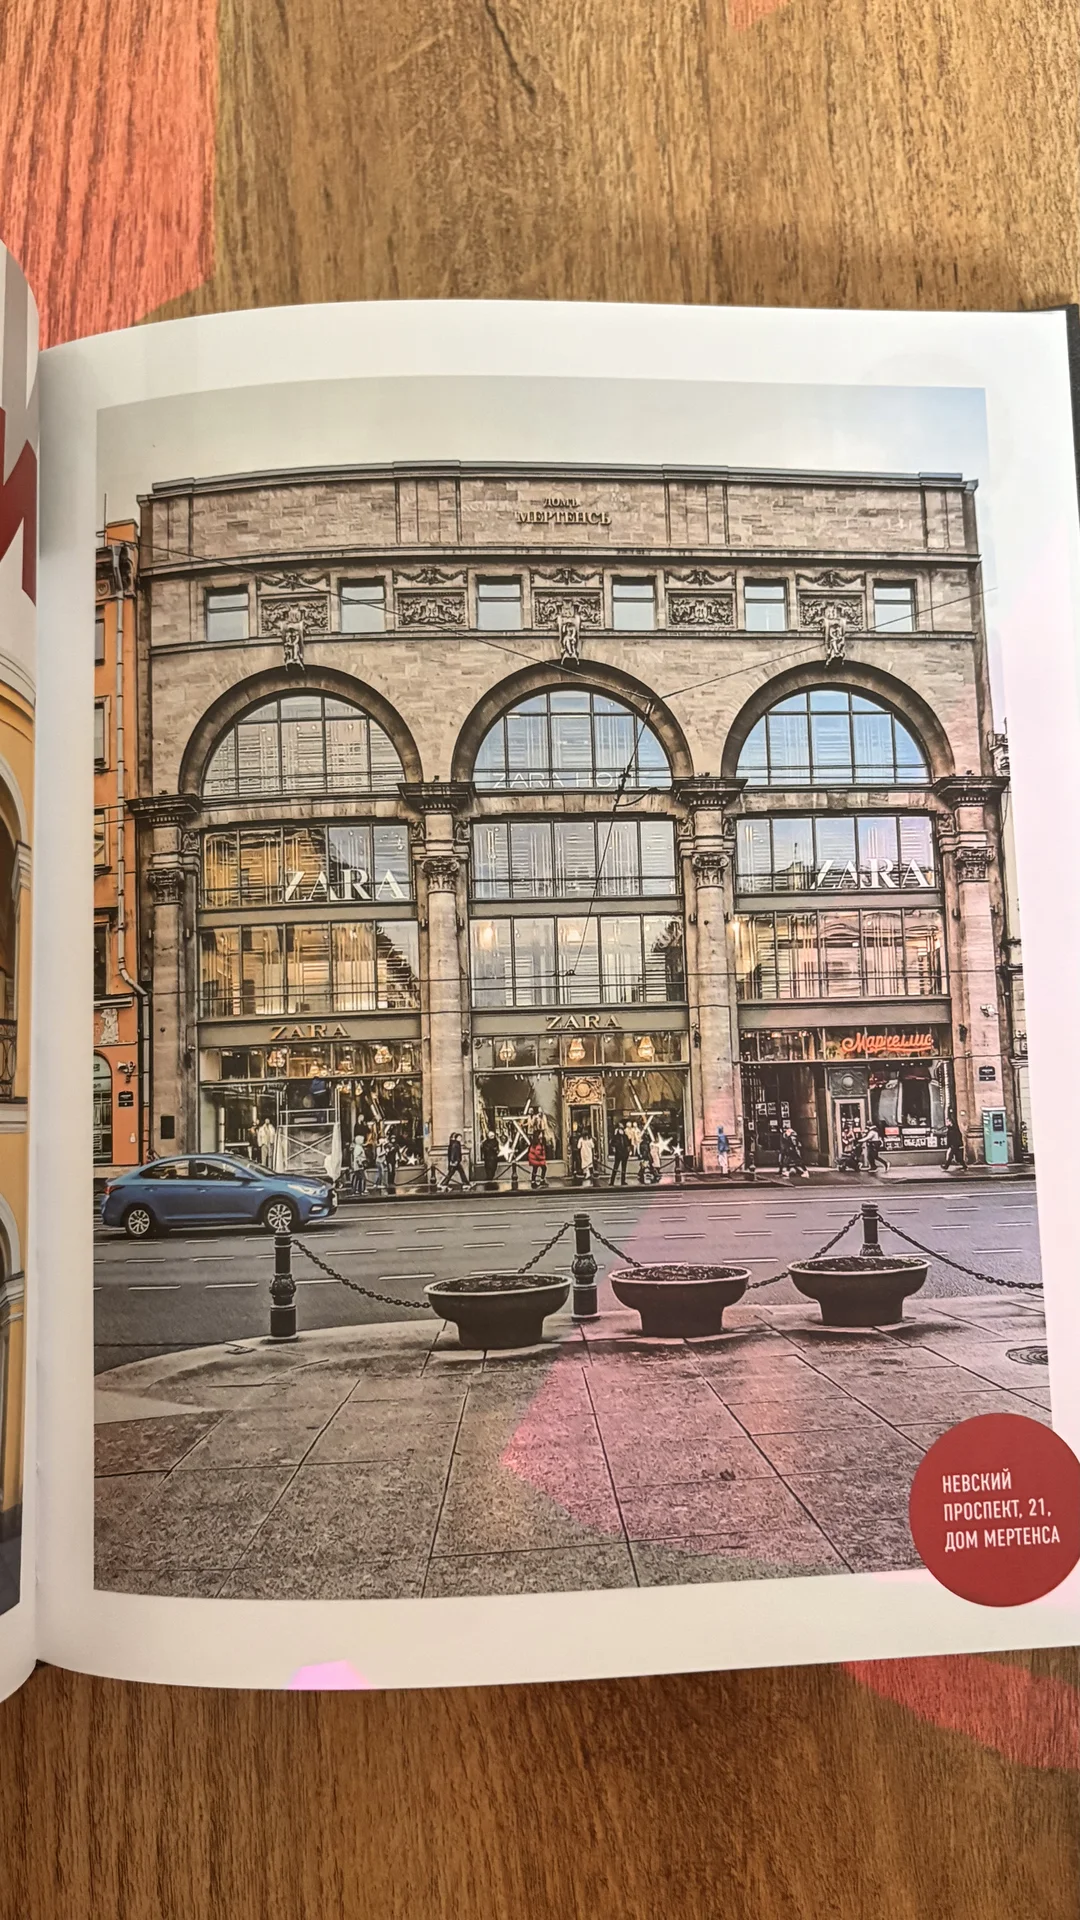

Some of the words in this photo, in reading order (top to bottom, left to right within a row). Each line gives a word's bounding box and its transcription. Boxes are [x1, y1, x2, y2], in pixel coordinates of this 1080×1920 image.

[493, 772, 564, 789] ZARA
[278, 868, 409, 903] ZARA
[809, 858, 936, 891] ZARA
[270, 1022, 351, 1041] ZARA
[546, 1014, 623, 1031] ZARA
[942, 1468, 1012, 1493] НЕВСКИЙ
[944, 1499, 1023, 1521] ПРОСПЕКТ,
[1028, 1498, 1052, 1517] 21,
[945, 1530, 978, 1553] ДОМ
[984, 1525, 1060, 1548] МЕРТЕНСА
